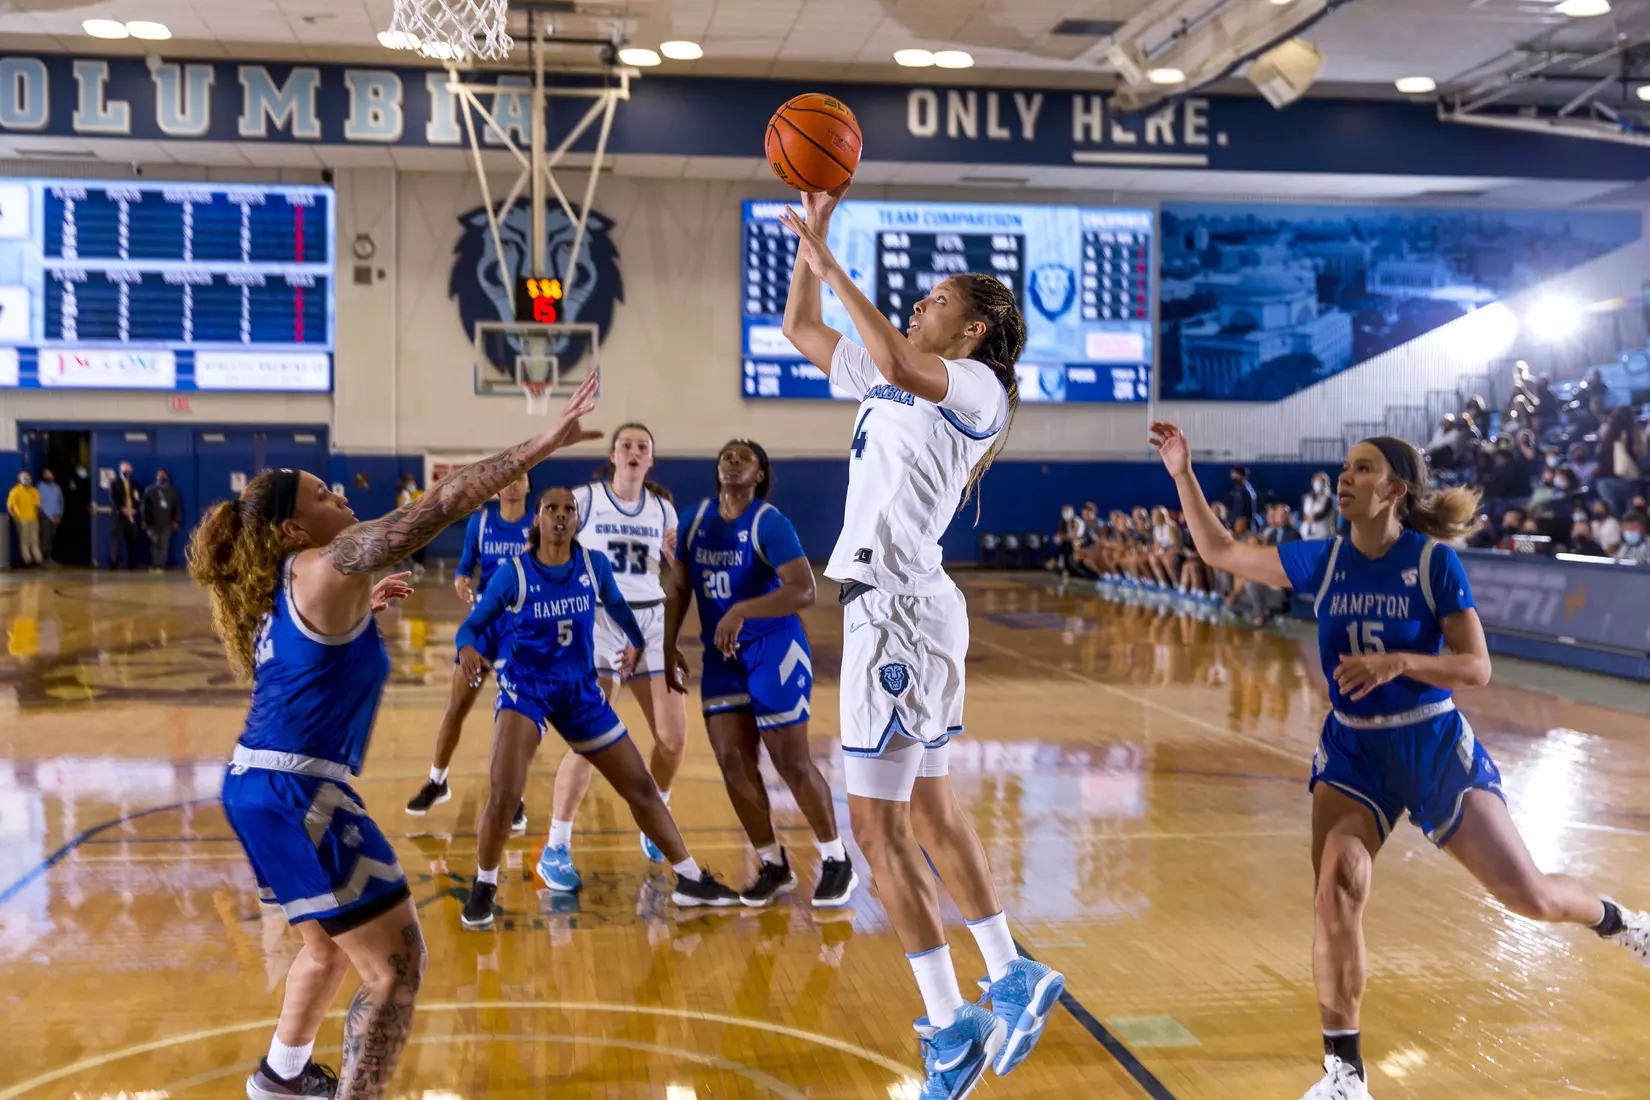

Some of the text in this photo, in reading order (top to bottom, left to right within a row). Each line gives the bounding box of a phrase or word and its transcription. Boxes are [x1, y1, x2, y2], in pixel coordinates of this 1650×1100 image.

[907, 88, 1044, 140] ONLY
[879, 209, 919, 225] TEAM
[595, 523, 660, 538] COLUMBIA
[608, 540, 649, 575] 33
[695, 546, 743, 568] HAMPTON
[702, 568, 732, 599] 20
[534, 594, 590, 619] HAMPTON
[1329, 591, 1410, 619] HAMPTON
[557, 618, 573, 646] 5
[1346, 620, 1387, 656] 15
